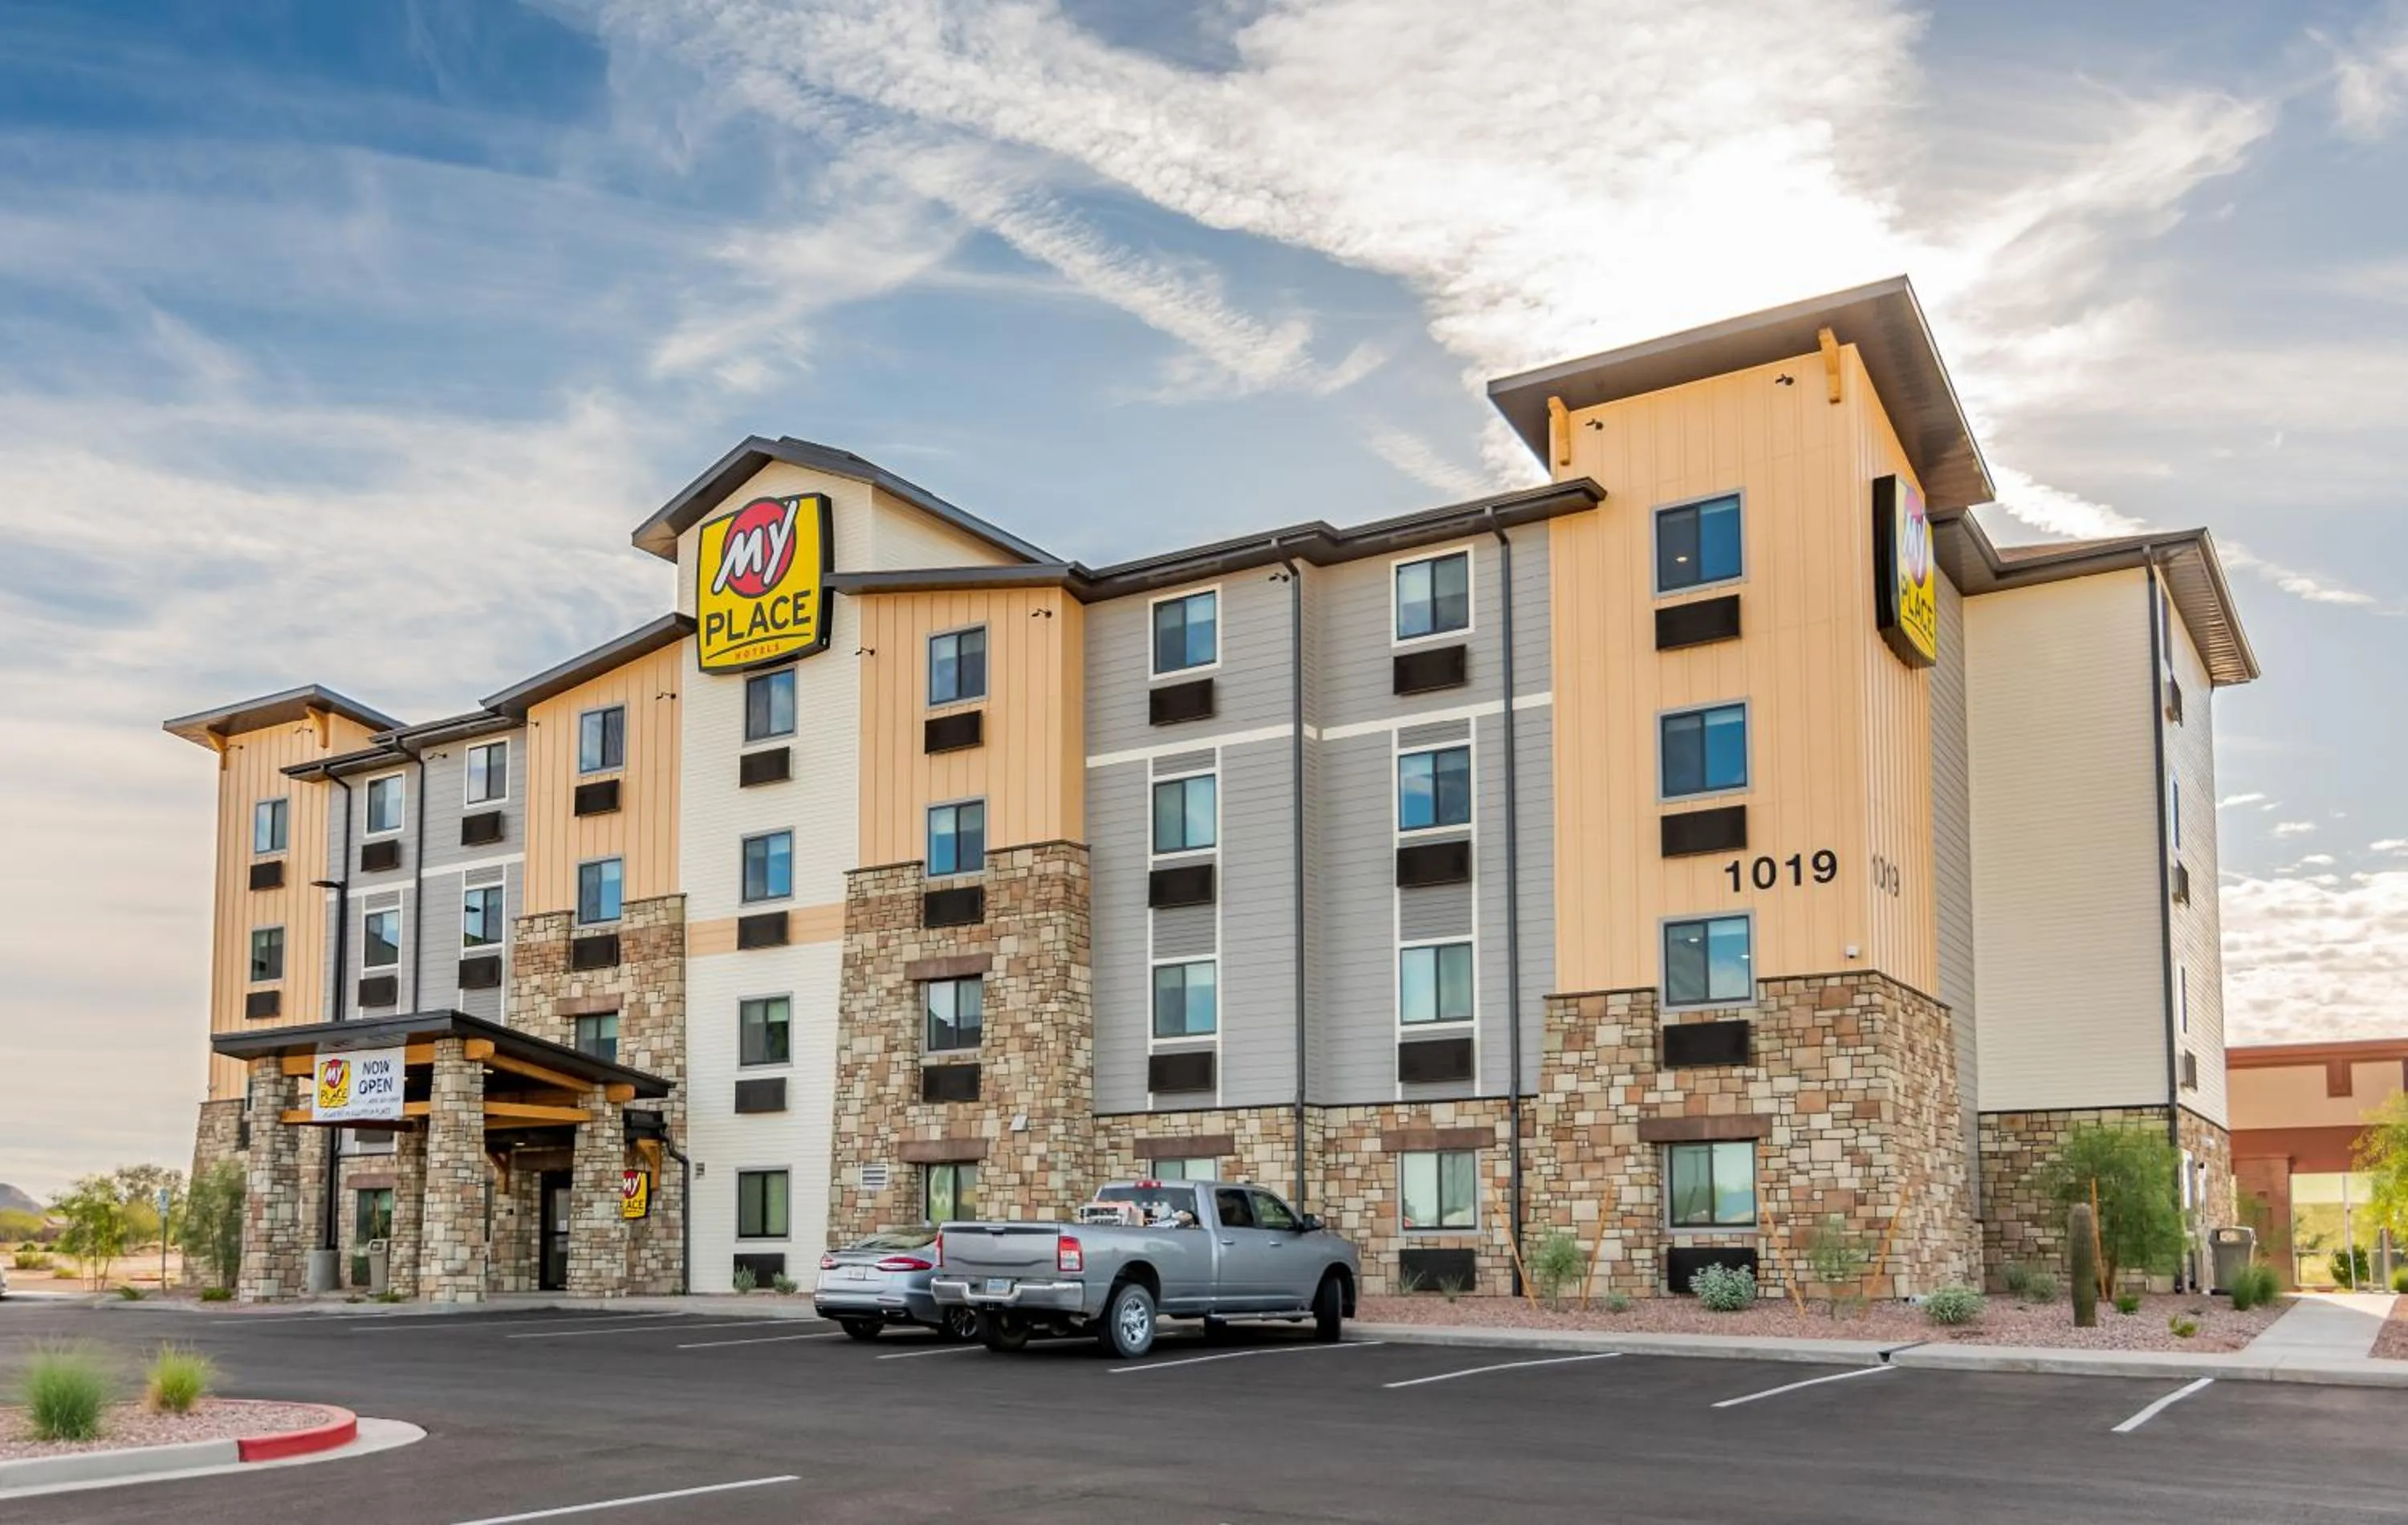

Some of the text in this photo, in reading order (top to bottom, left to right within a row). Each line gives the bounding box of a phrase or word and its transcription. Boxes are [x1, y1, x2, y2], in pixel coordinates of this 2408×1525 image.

[706, 590, 811, 647] PLACE
[1901, 571, 1934, 639] PLACE
[734, 643, 779, 661] HOTELS
[1724, 849, 1837, 893] 1019
[1873, 854, 1900, 897] 1019
[359, 1077, 393, 1095] OPEN
[362, 1059, 391, 1076] NOW
